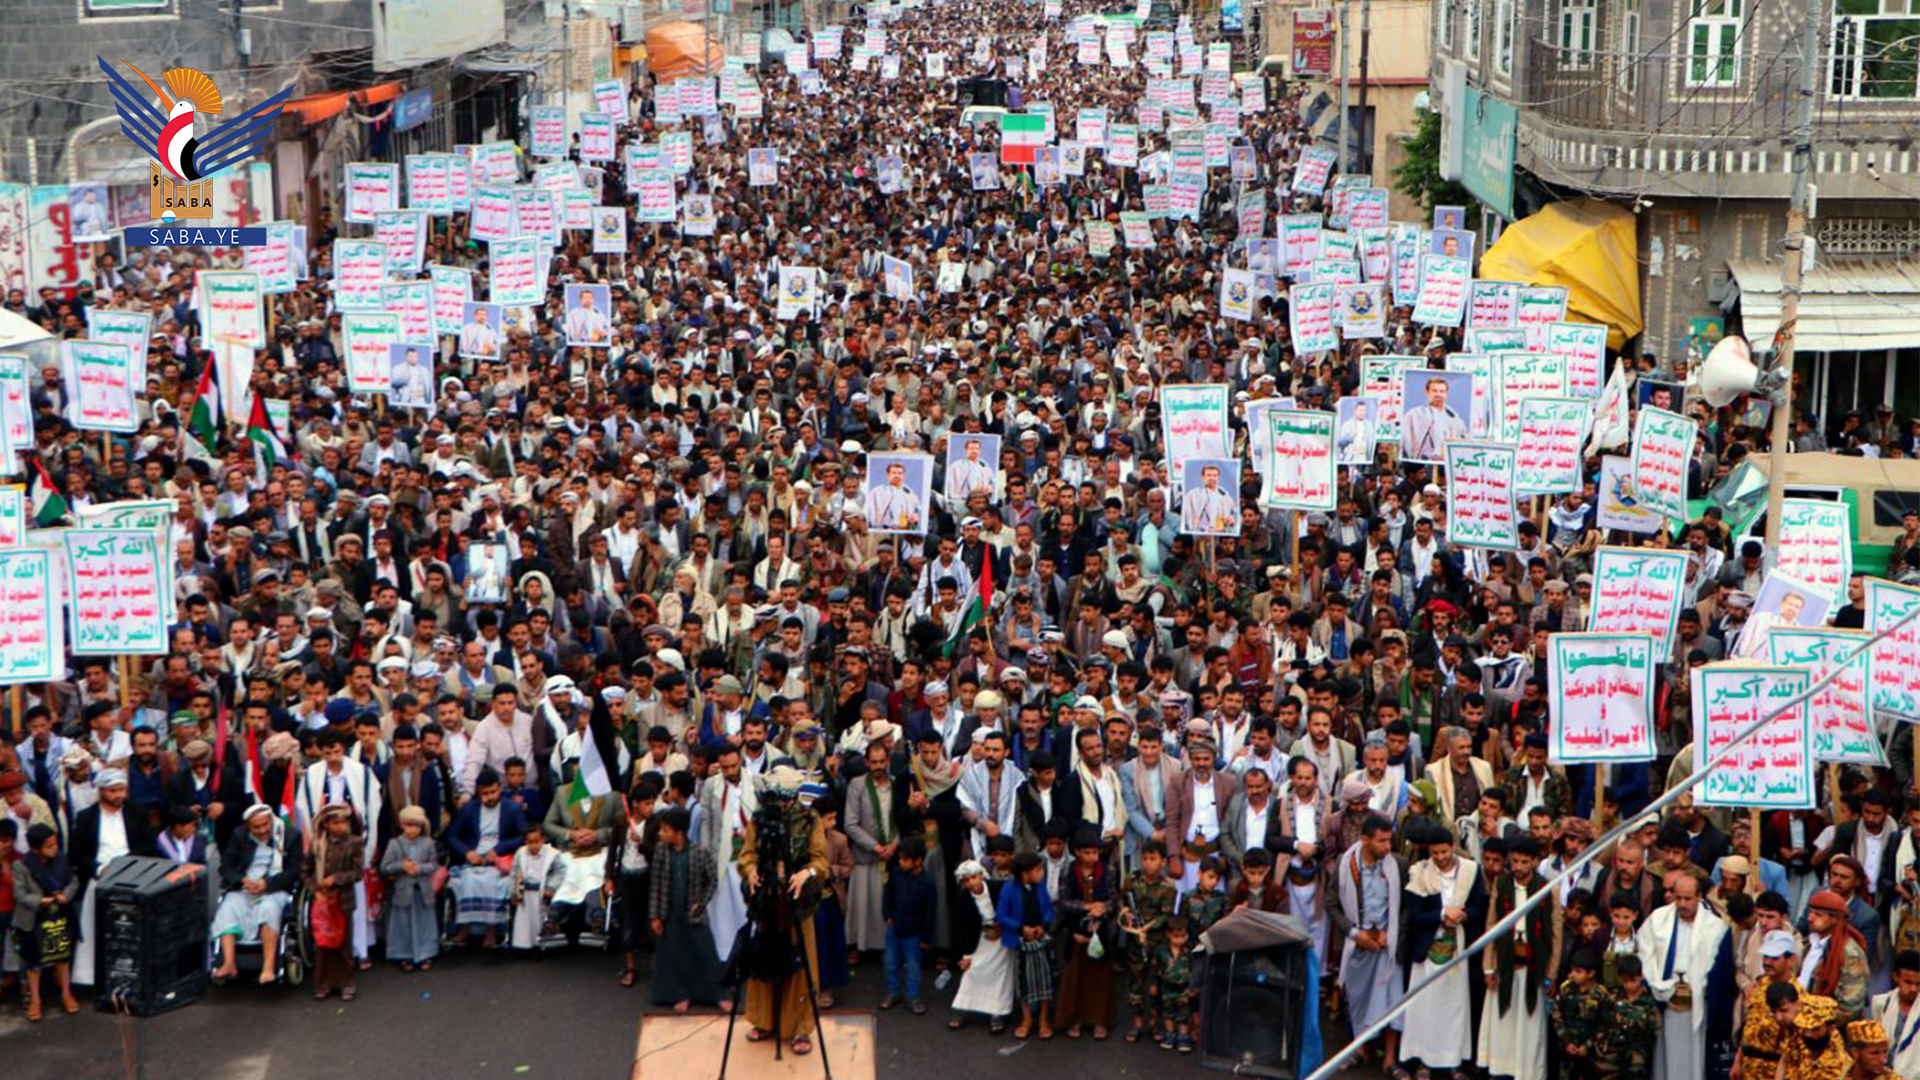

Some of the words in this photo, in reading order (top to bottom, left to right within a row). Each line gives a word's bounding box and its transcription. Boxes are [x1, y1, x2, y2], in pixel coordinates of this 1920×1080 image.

[74, 534, 118, 562] أكبر
[121, 536, 152, 556] الله
[1648, 560, 1678, 580] الله
[1562, 646, 1645, 675] قاطعوا
[1709, 674, 1766, 706] أكبر
[1767, 677, 1803, 698] الله
[1708, 771, 1756, 797] للإسلام
[1761, 770, 1804, 799] النصر
